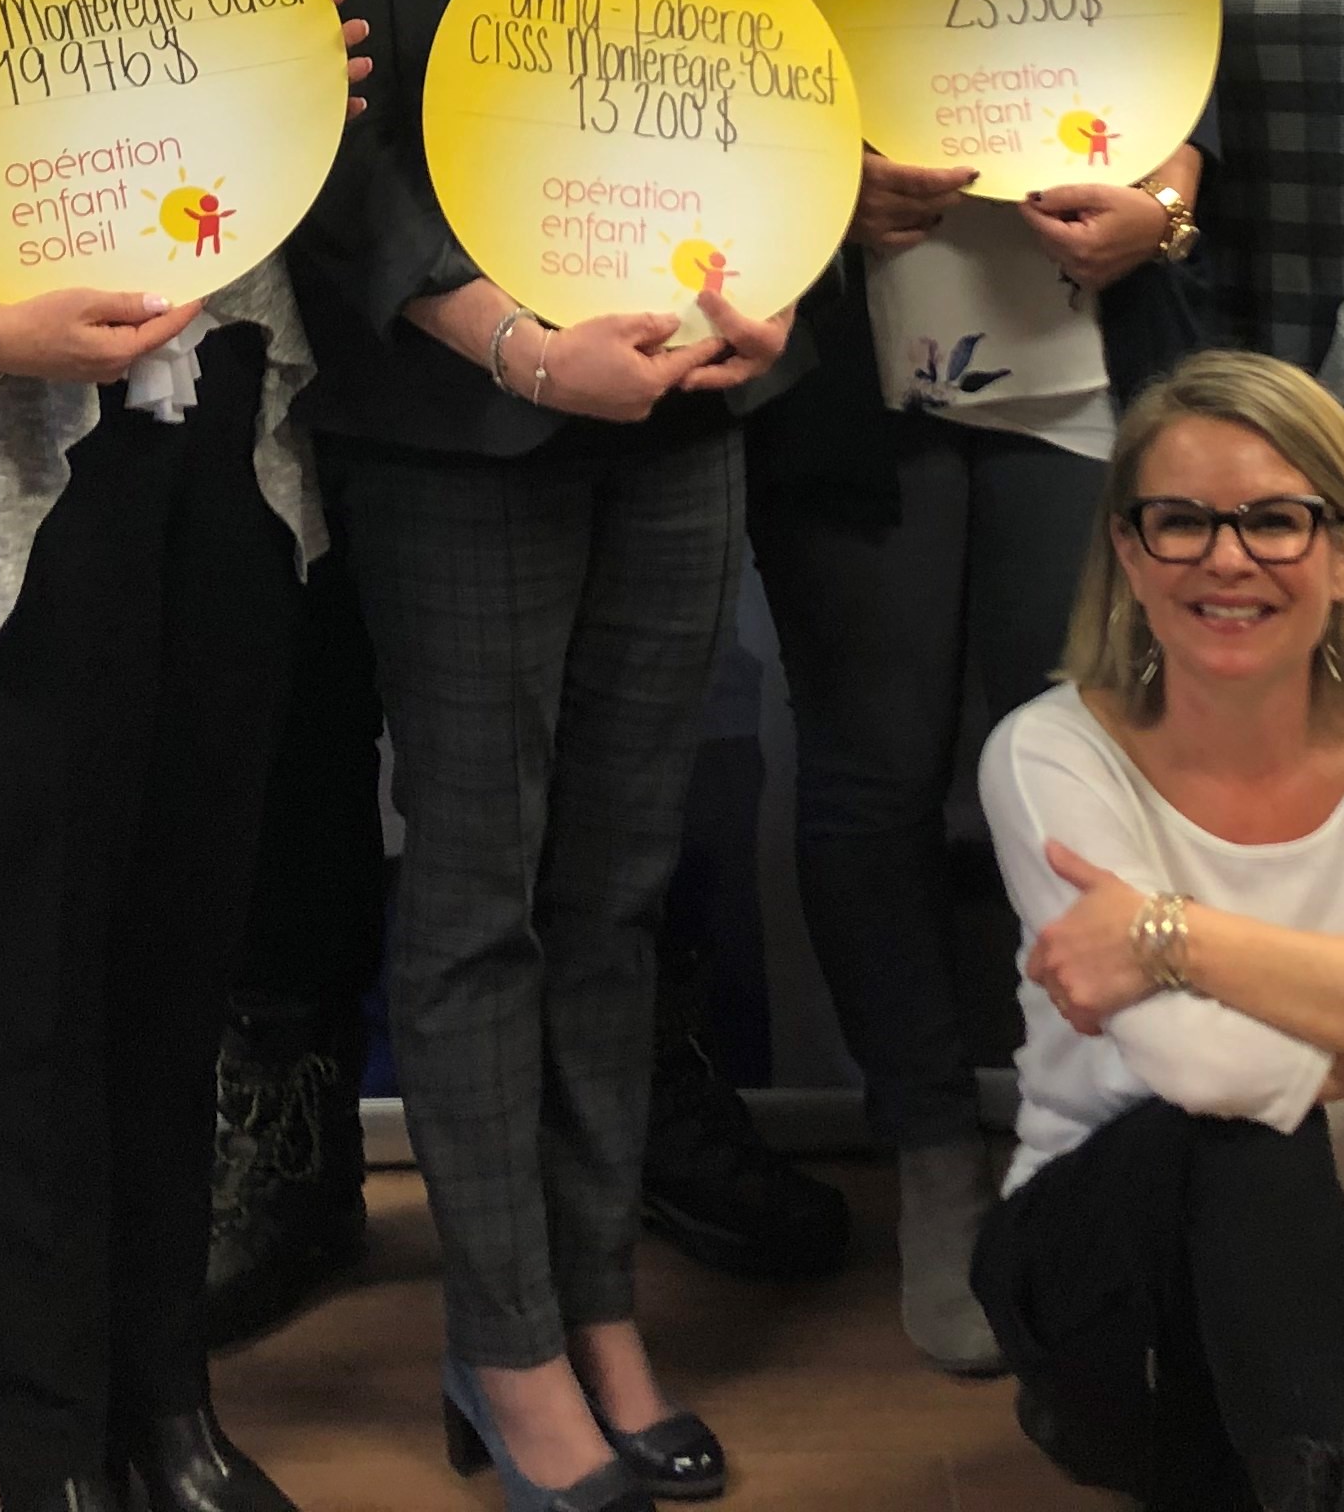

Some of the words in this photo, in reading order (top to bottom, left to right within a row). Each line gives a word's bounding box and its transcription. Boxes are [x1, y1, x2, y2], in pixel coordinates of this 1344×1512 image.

[931, 64, 1078, 99] opération
[936, 97, 1032, 129] enfant
[941, 128, 1023, 157] soleil
[5, 134, 182, 192] opération
[12, 179, 128, 233] enfant
[542, 175, 701, 213] opération
[19, 220, 117, 267] soleil
[541, 212, 646, 248] enfant
[540, 248, 629, 279] soleil
